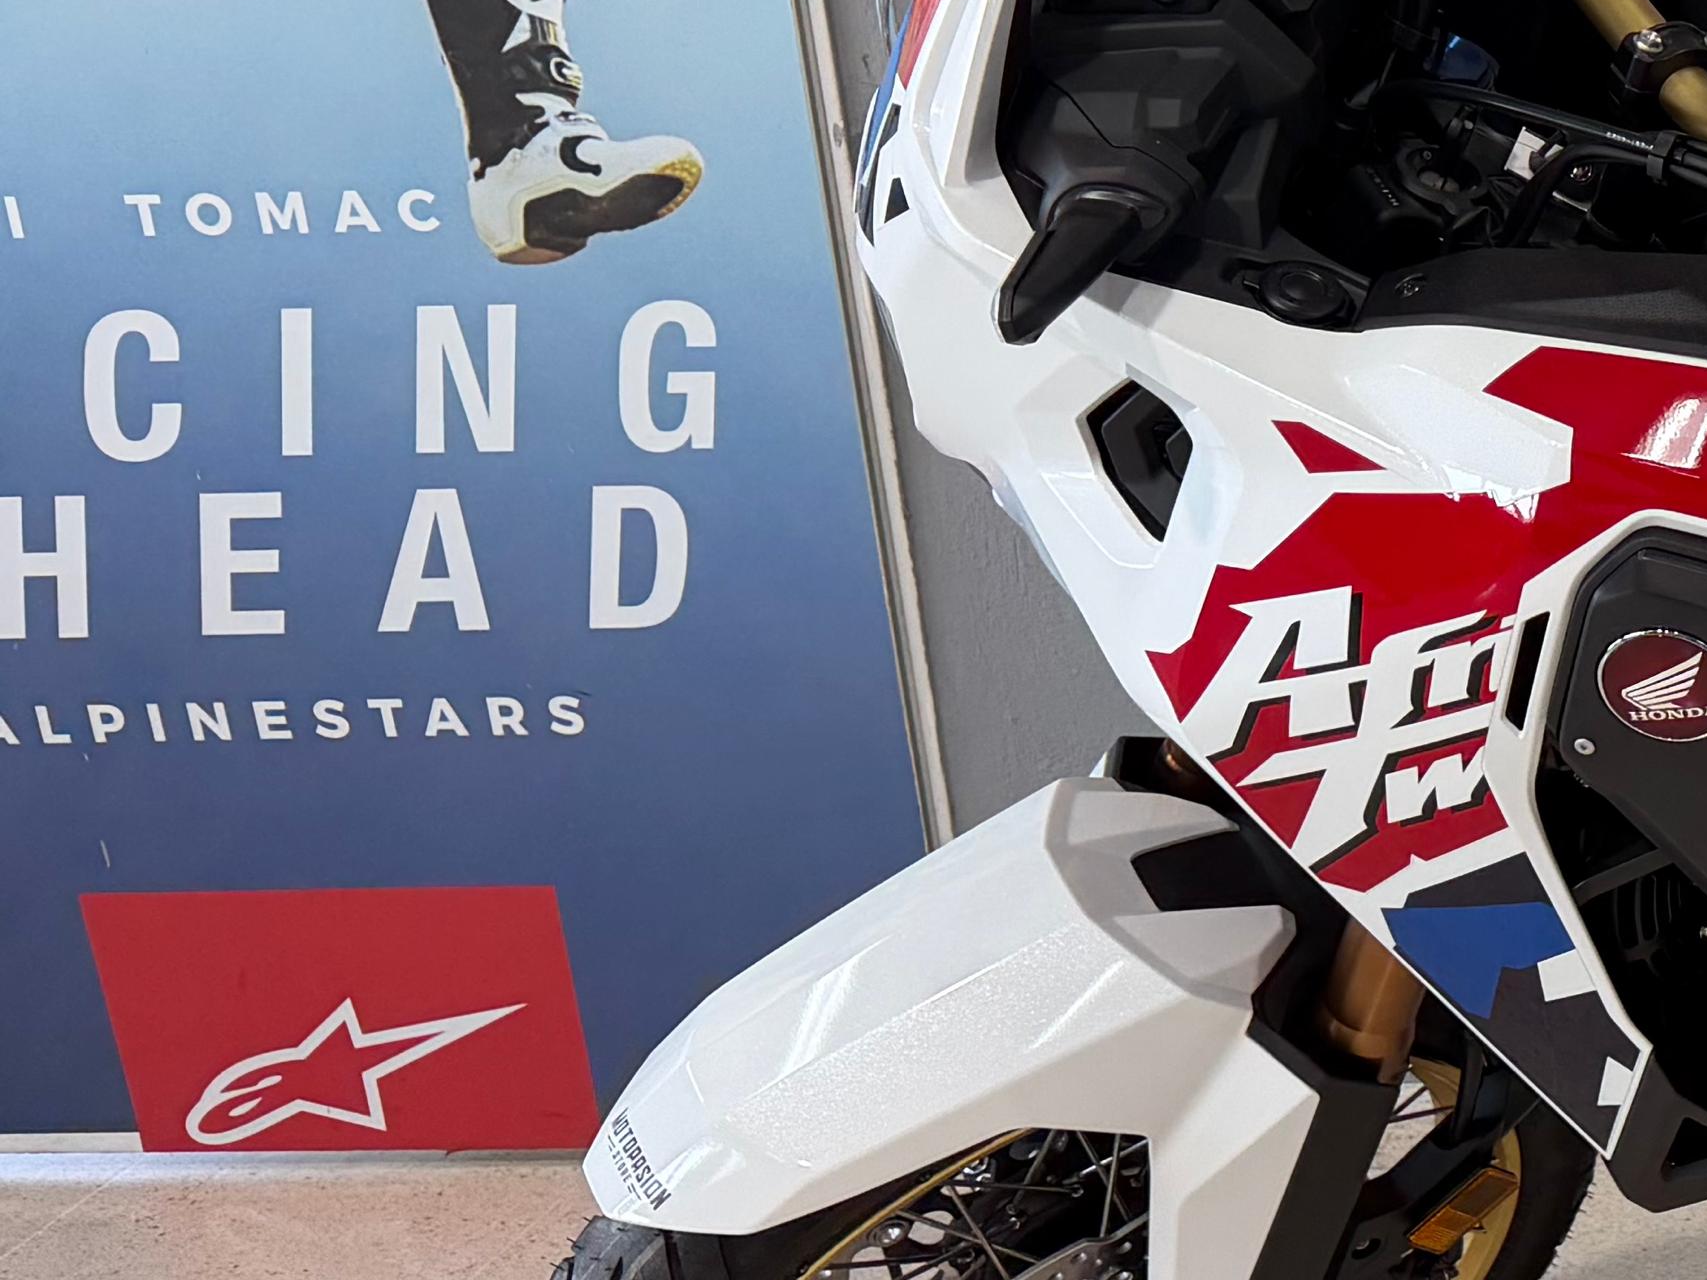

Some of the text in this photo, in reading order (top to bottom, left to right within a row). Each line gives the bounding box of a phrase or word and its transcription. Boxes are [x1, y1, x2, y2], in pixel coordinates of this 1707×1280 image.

[124, 189, 441, 236] TOMAC
[83, 299, 719, 463] CING
[0, 485, 689, 639] HEAD
[611, 1107, 672, 1211] MOTOPASION
